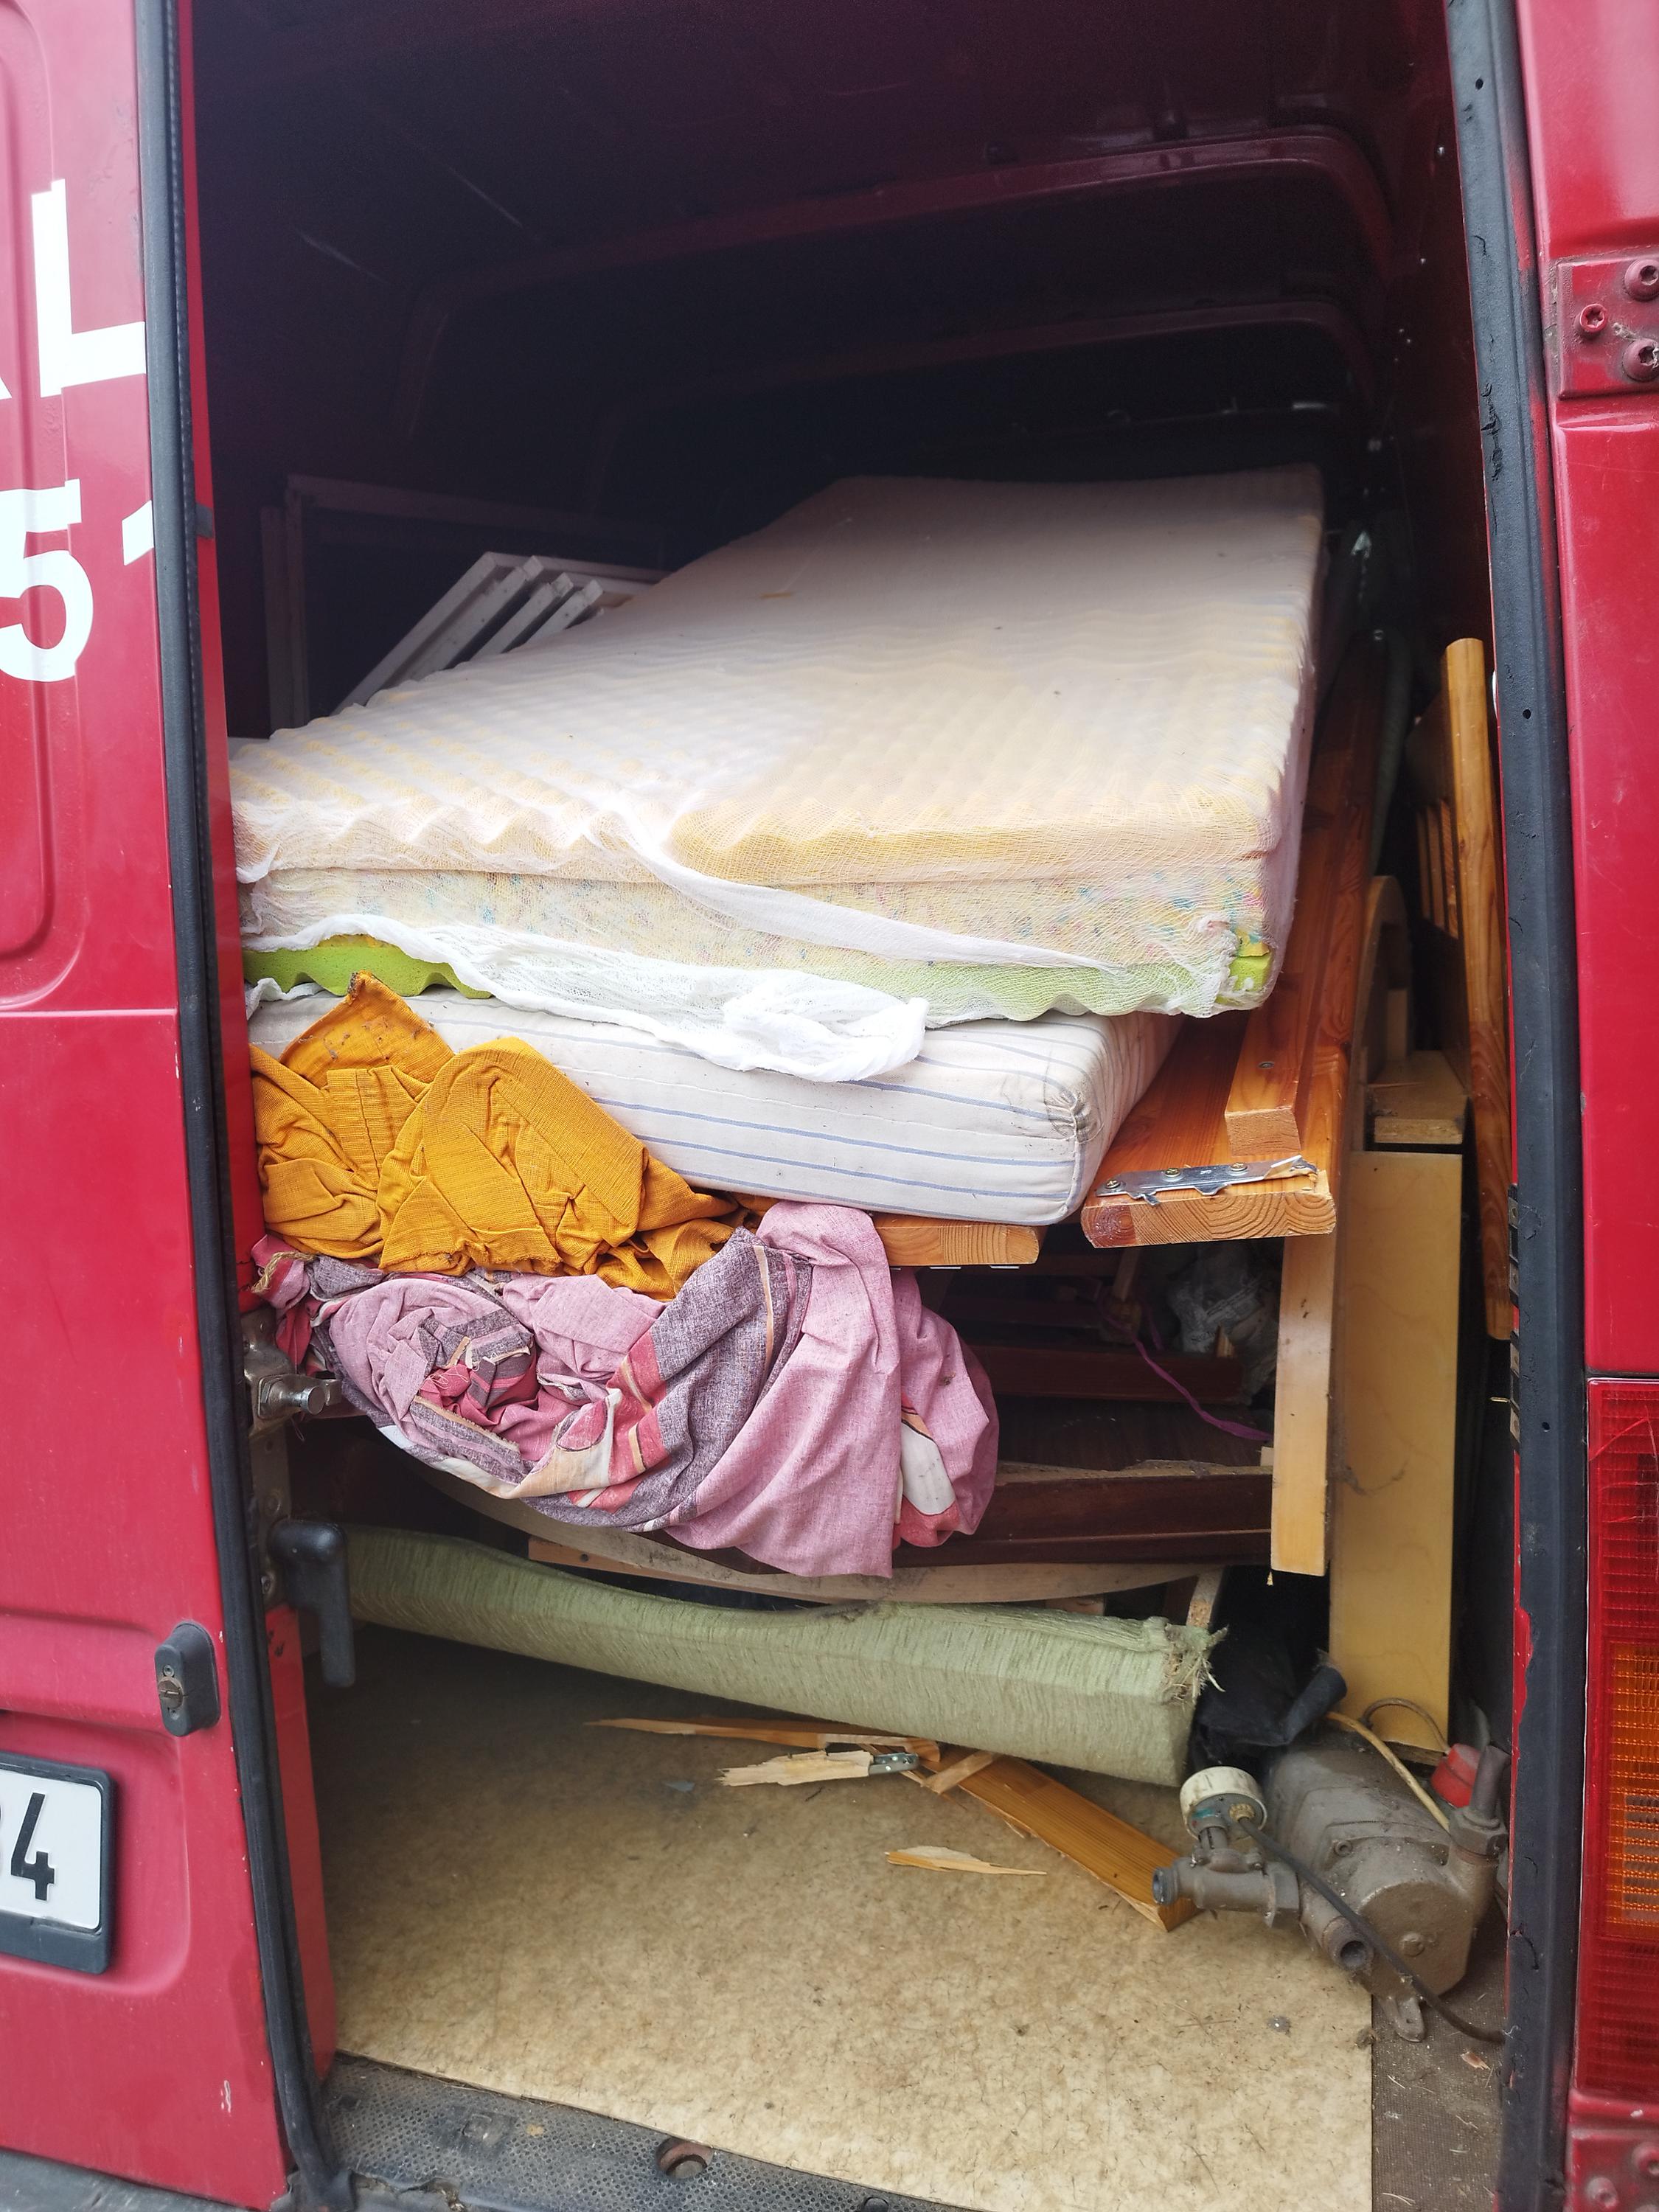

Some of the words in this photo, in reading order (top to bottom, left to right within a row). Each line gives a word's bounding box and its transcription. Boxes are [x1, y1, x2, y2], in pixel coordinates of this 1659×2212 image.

[0, 178, 146, 400] L
[0, 478, 154, 682] 5
[10, 1792, 55, 1901] 4
